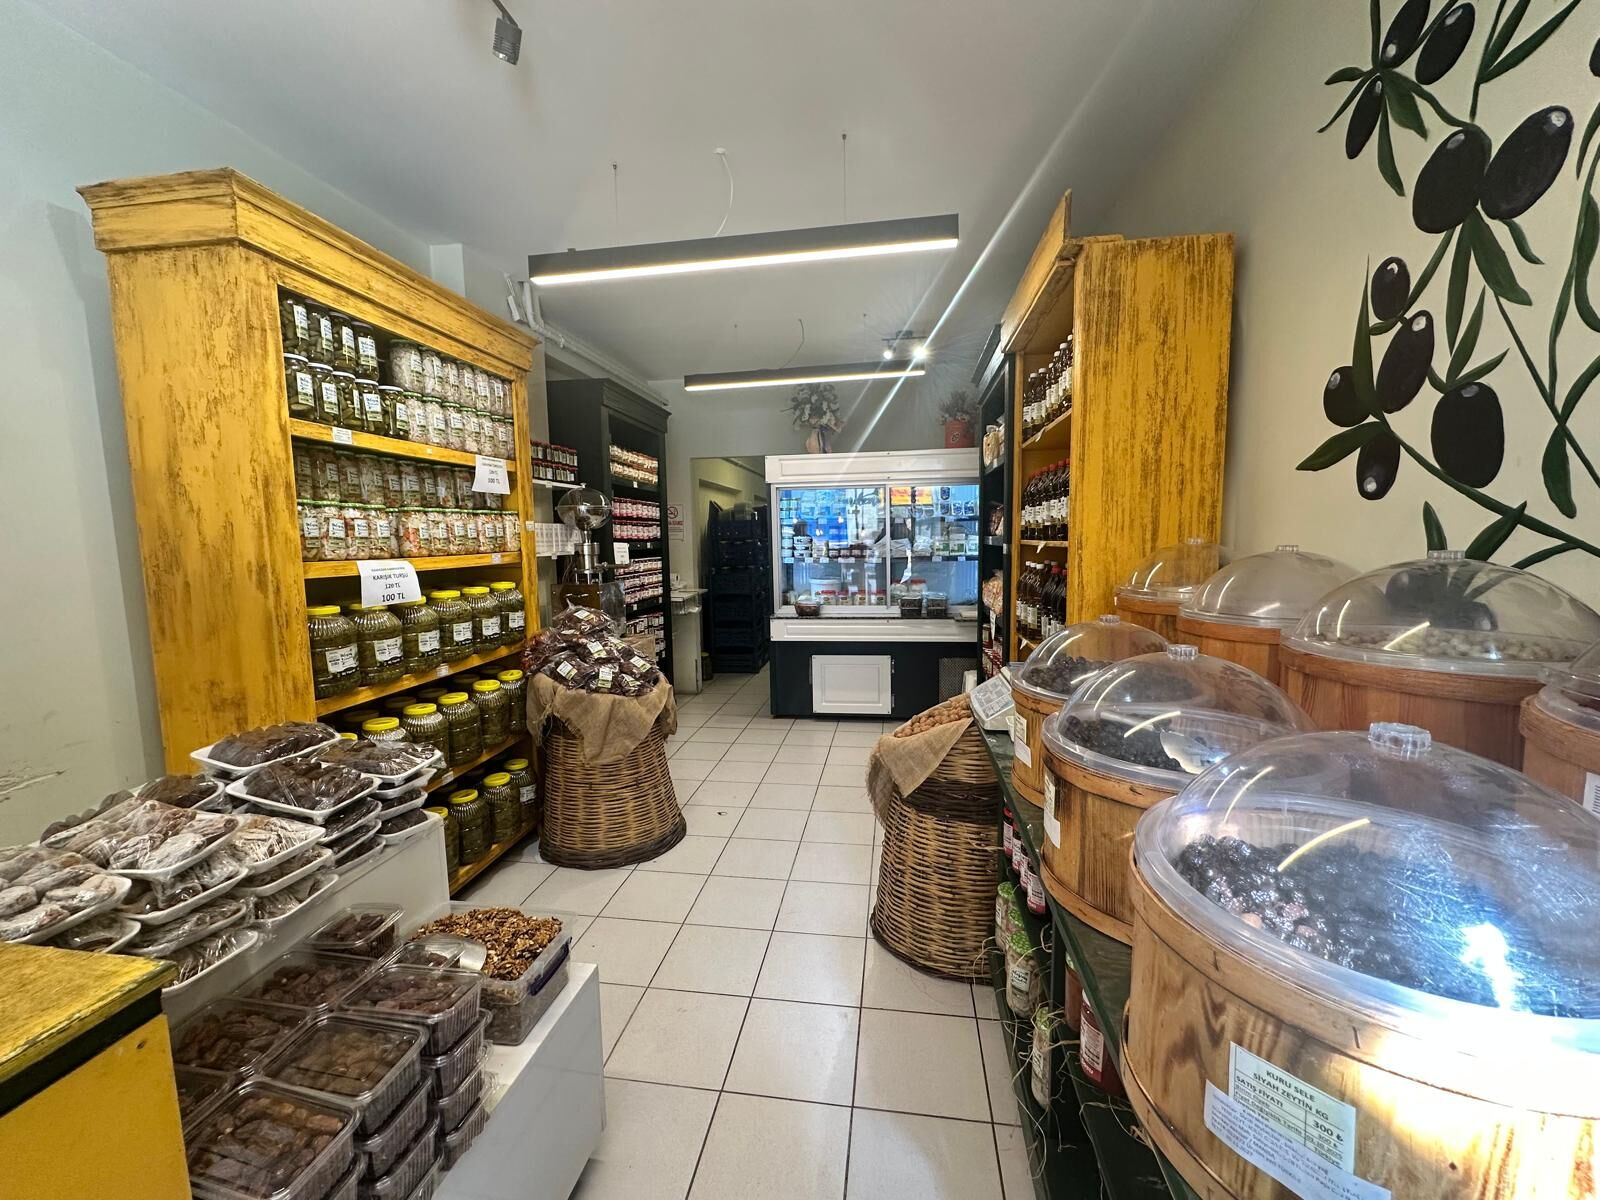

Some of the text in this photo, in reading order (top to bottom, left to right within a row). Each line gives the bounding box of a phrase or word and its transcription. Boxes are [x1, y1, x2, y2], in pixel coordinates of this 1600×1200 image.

[382, 594, 395, 602] 100
[1253, 1072, 1329, 1120] SİYAH ZEYTİN KG
[1266, 1070, 1315, 1102] KURU SELE
[1236, 1075, 1257, 1093] SATIŞ
[1258, 1087, 1283, 1108] FİYATI
[1313, 1120, 1333, 1136] 300
[1319, 1134, 1331, 1145] 300
